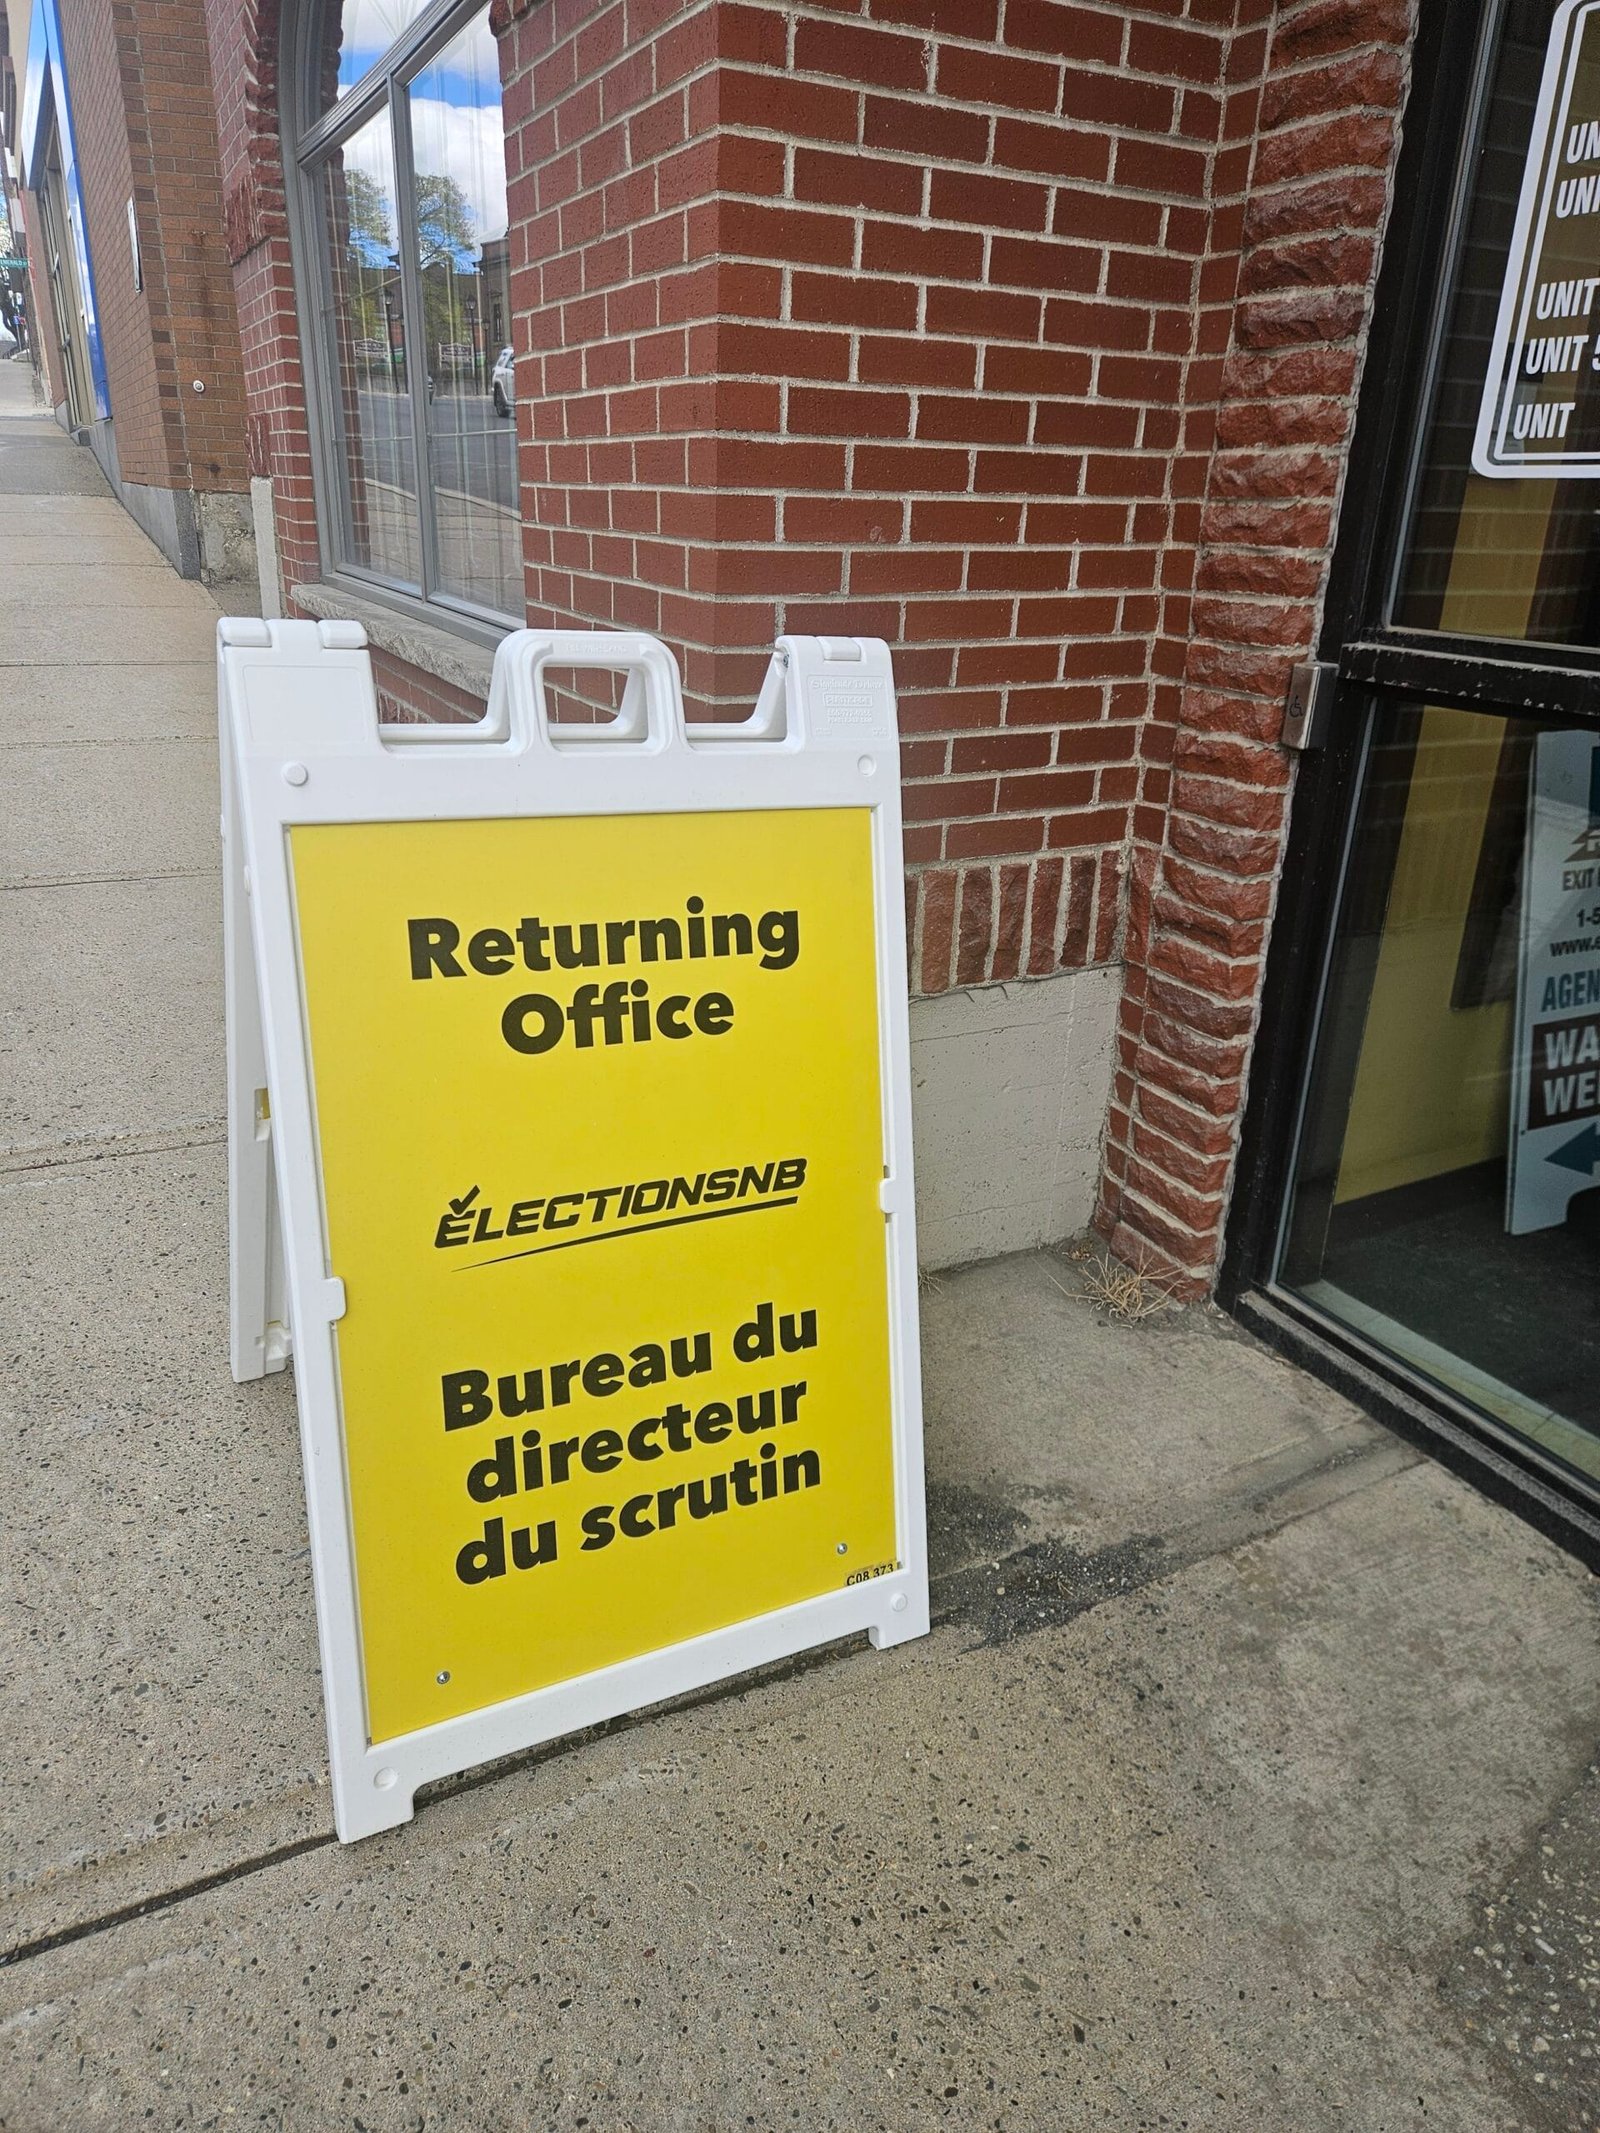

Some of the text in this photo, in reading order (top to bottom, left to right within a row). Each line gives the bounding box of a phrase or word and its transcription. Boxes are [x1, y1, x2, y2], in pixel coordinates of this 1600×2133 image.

[1536, 277, 1600, 321] UNIT
[1526, 334, 1589, 375] UNIT
[1513, 402, 1577, 440] UNIT
[1563, 868, 1595, 891] EXIT
[408, 896, 798, 981] Returning
[502, 979, 735, 1055] Office
[1543, 1068, 1600, 1116] WE
[442, 1302, 818, 1432] Bureau du
[467, 1380, 807, 1504] directeur
[456, 1443, 821, 1585] du scrutin
[873, 1563, 894, 1578] 373
